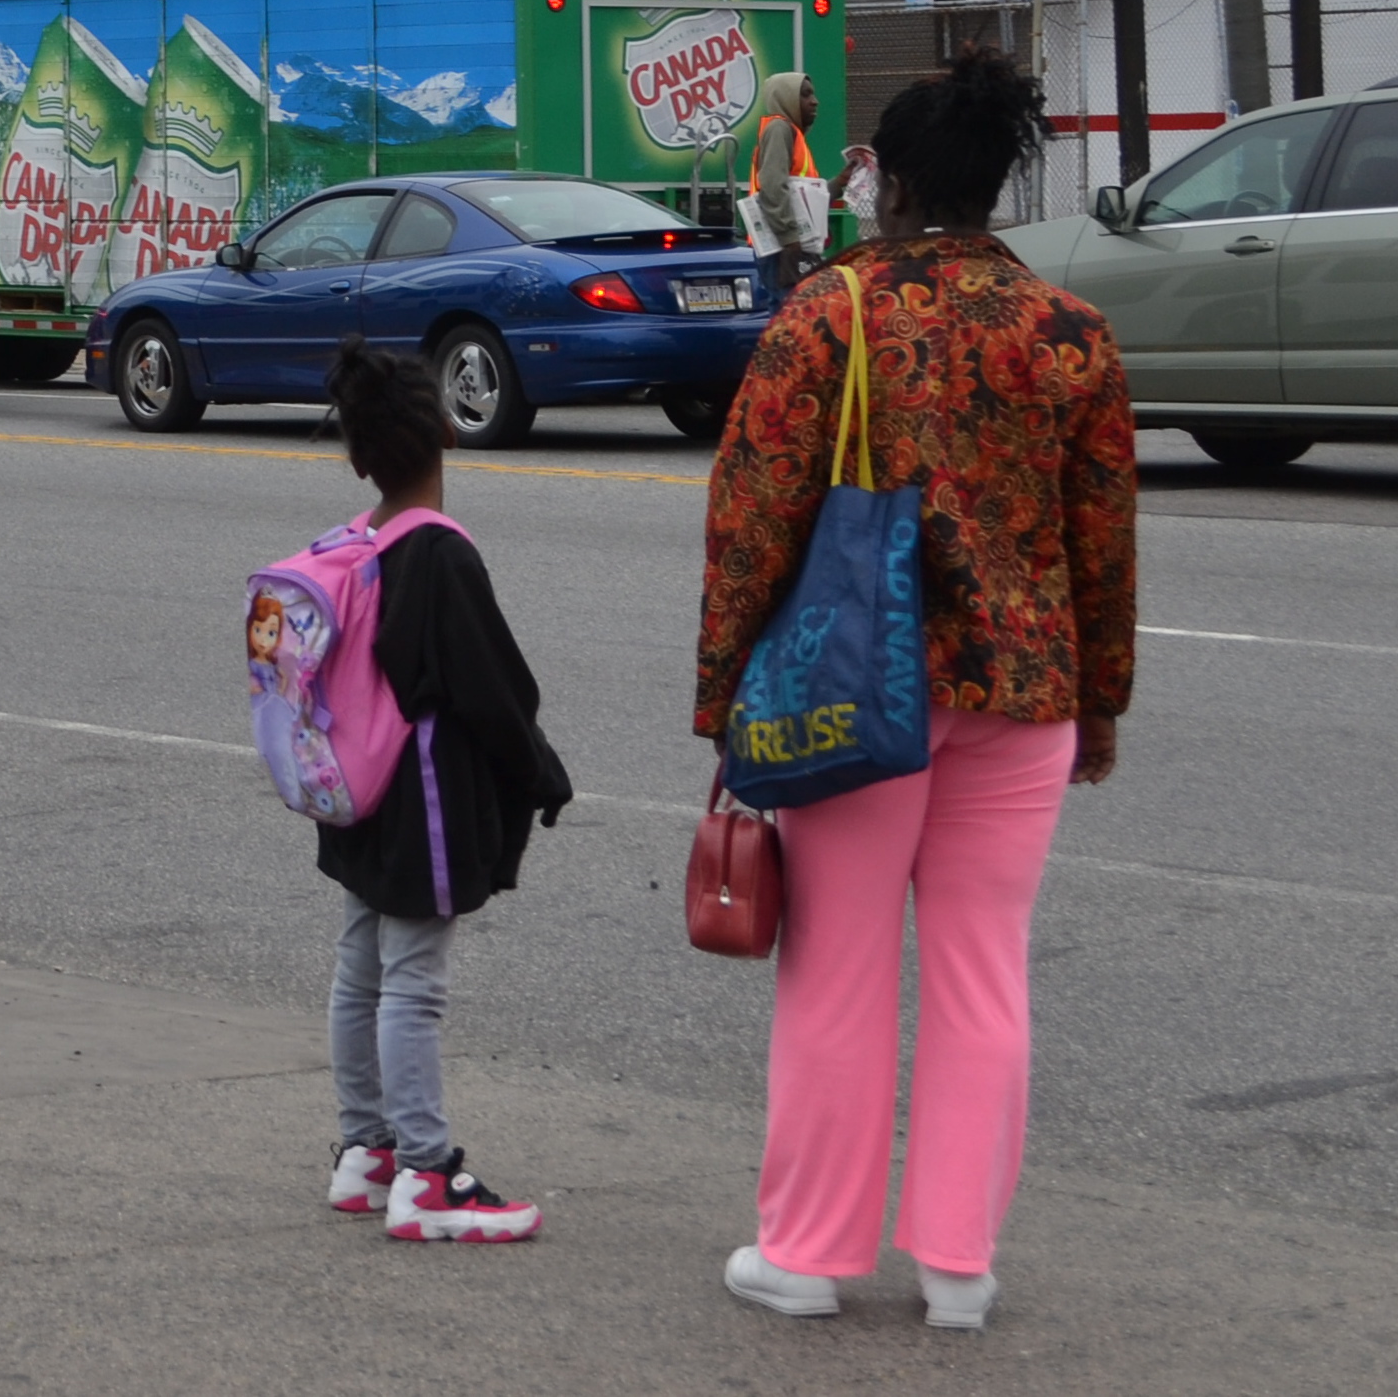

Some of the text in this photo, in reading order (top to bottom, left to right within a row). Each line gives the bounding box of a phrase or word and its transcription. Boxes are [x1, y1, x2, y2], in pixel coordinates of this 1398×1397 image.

[631, 27, 750, 106] CANADA
[670, 70, 726, 122] DRY
[2, 152, 110, 245] CANADA
[20, 213, 84, 275] DRY
[887, 517, 917, 602] OLD
[885, 610, 916, 733] NAVY
[748, 703, 858, 764] REUSE
